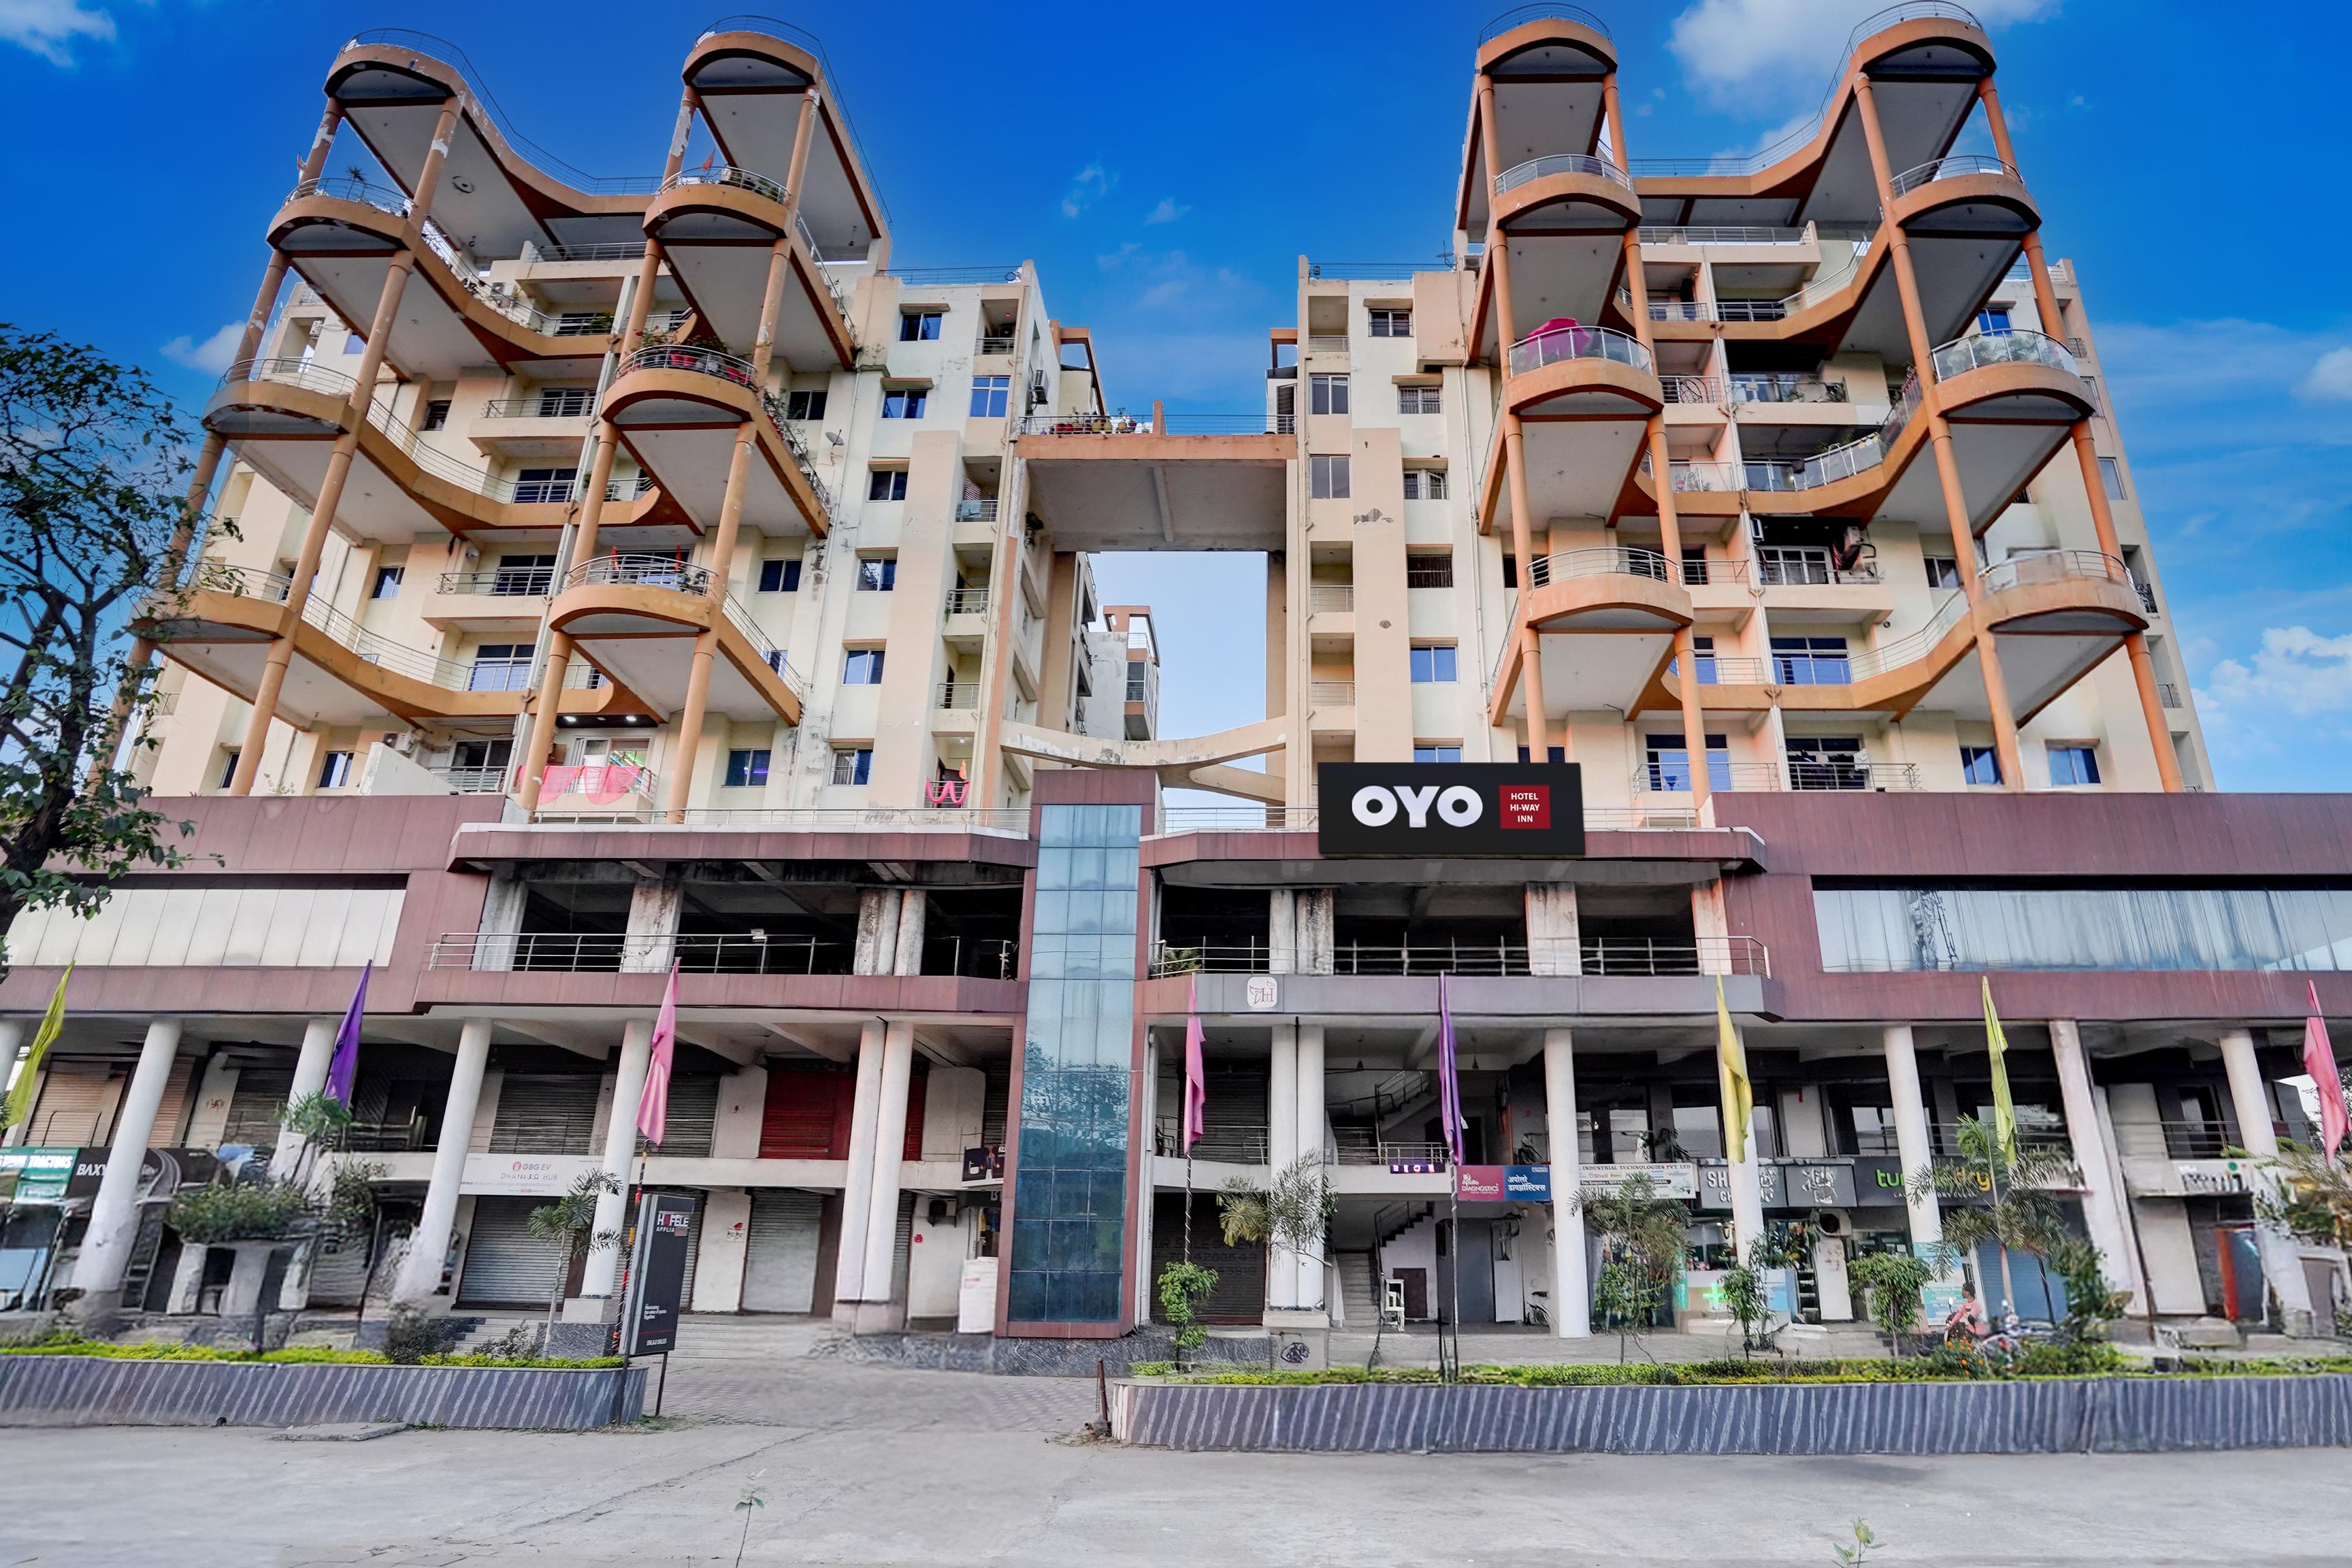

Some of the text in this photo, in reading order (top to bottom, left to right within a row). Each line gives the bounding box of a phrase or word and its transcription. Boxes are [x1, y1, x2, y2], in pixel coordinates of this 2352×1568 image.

[1511, 792, 1539, 800] HOTEL
[1352, 785, 1483, 828] OYO
[1510, 804, 1540, 812] HI-WAY
[1517, 815, 1533, 823] INN
